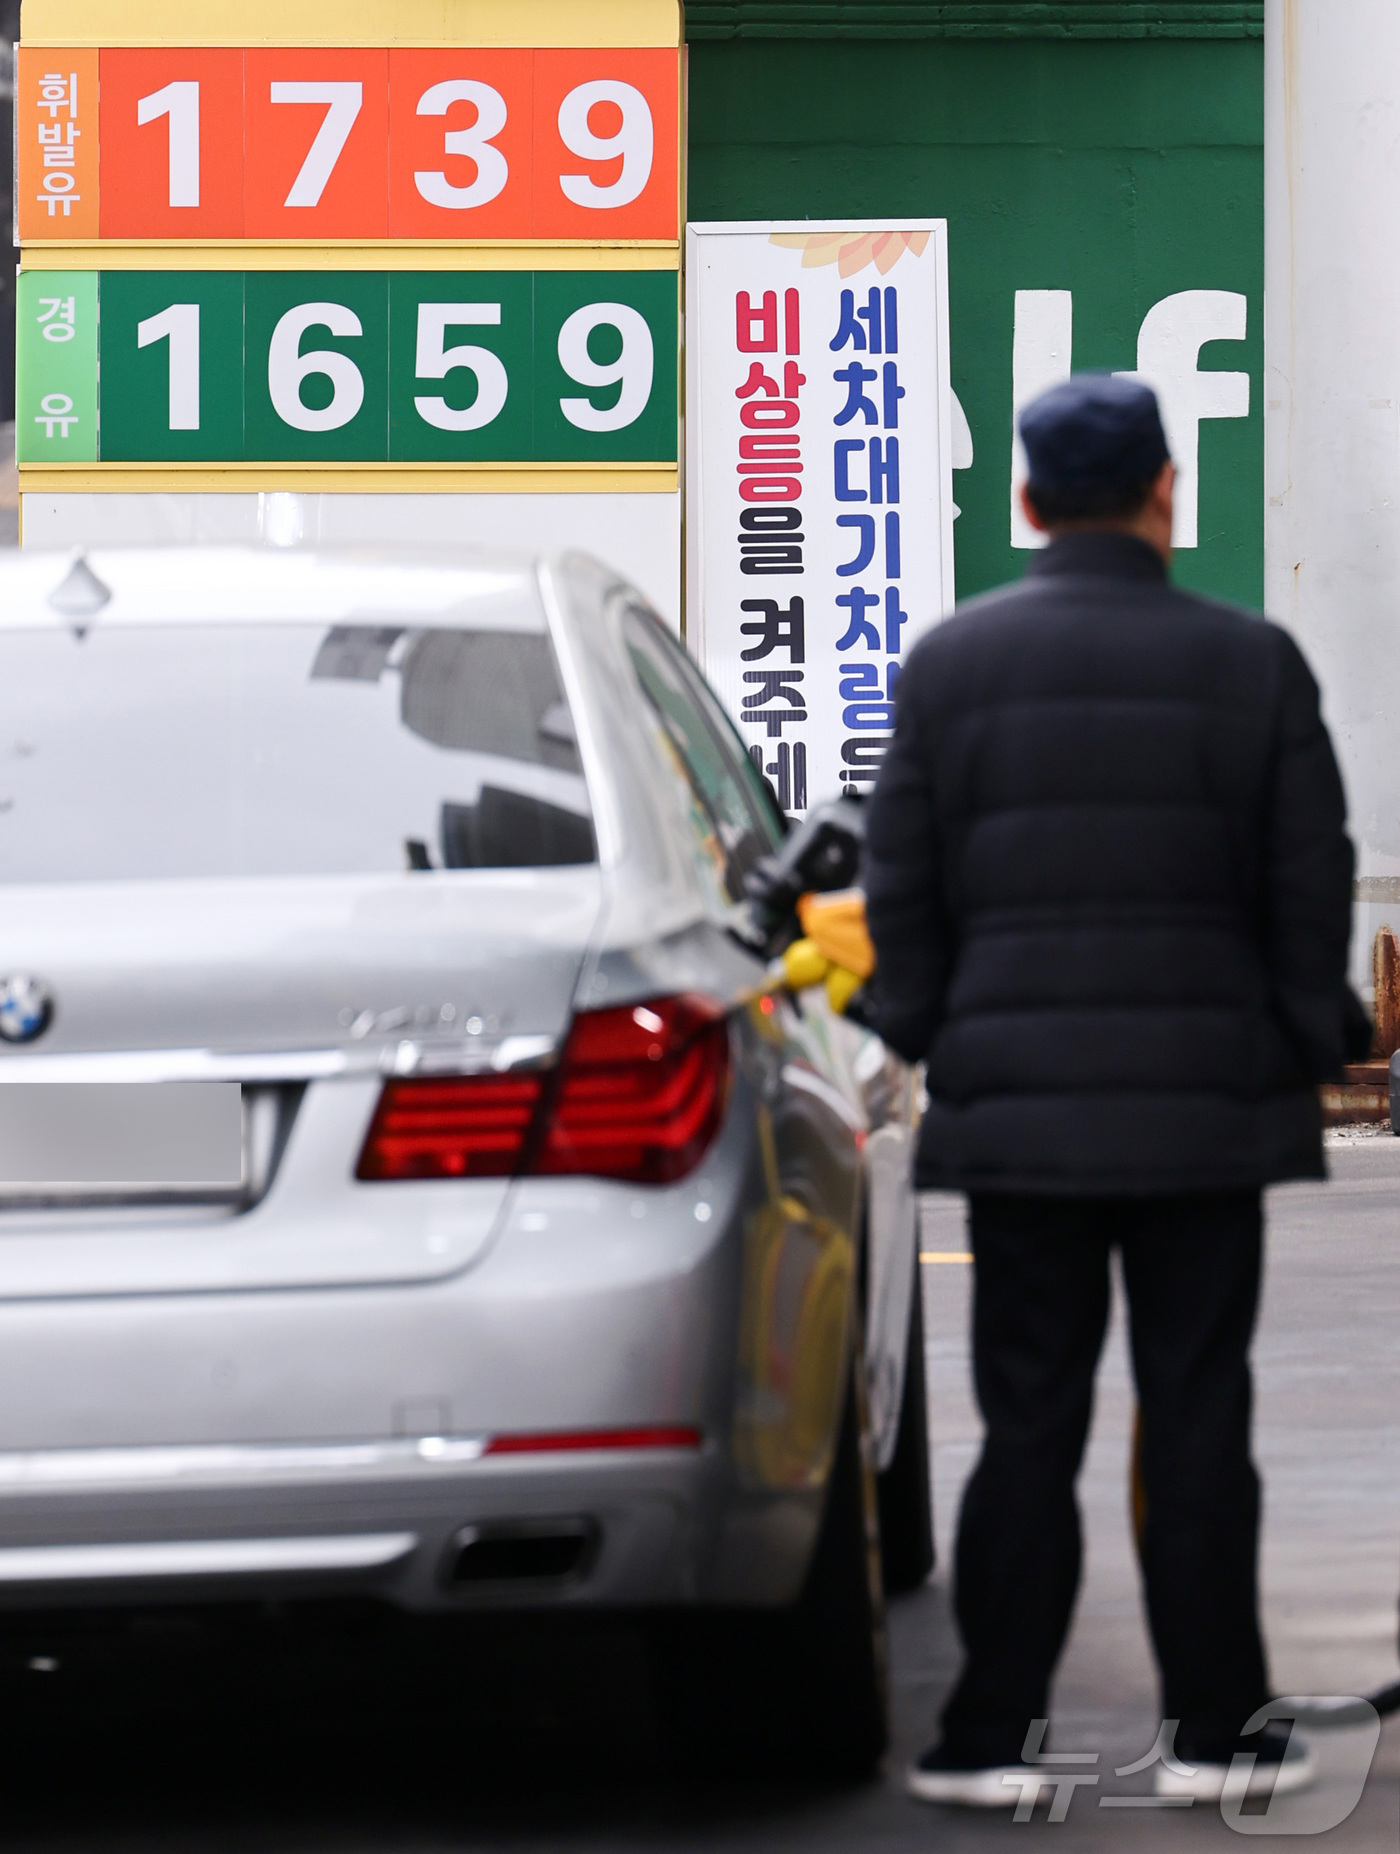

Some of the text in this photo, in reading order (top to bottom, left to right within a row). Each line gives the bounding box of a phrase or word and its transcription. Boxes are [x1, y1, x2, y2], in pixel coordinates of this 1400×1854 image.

[36, 72, 81, 217] 휘발유
[136, 79, 655, 210] 1739
[136, 301, 655, 432] 1659
[950, 289, 1250, 548] lf
[734, 287, 808, 824] 비상등을 켜주세
